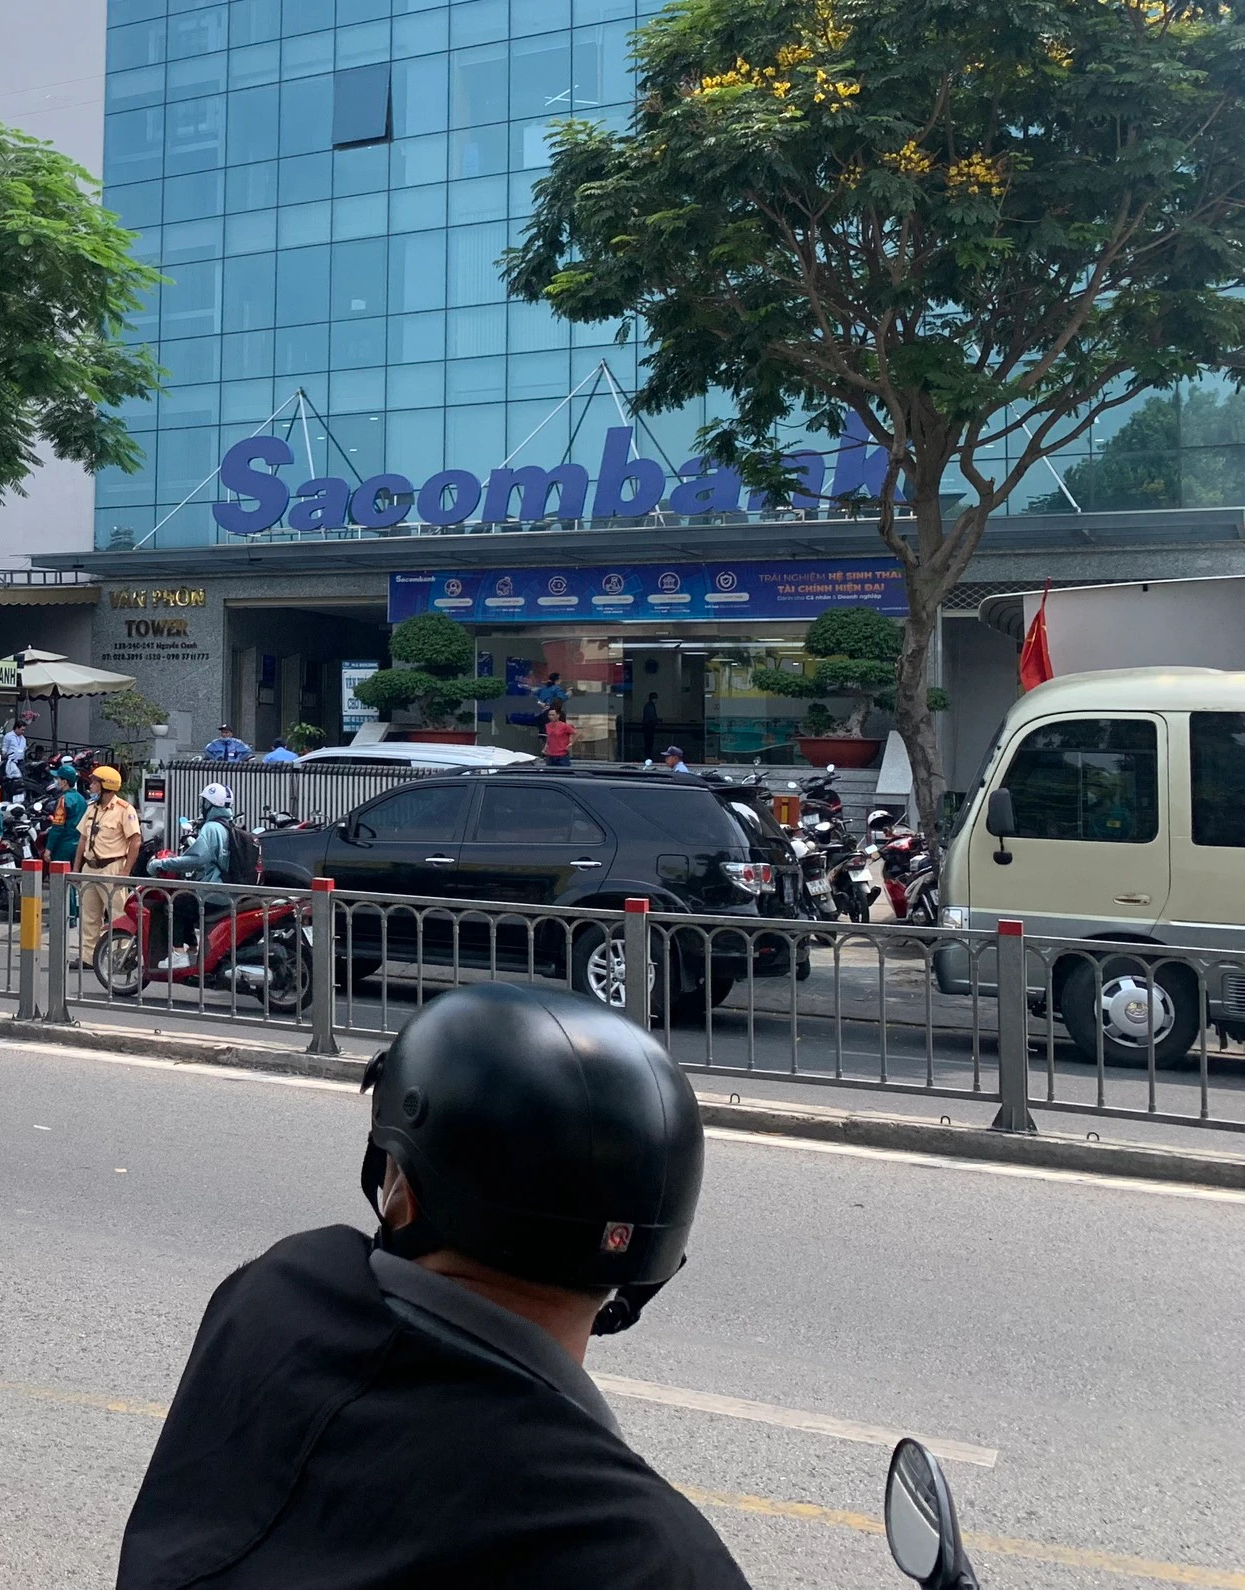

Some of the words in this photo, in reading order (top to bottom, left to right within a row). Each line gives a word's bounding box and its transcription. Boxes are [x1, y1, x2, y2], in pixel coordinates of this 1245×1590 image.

[212, 410, 915, 534] Sacombank
[846, 571, 872, 580] SINH
[124, 618, 189, 638] TOWER
